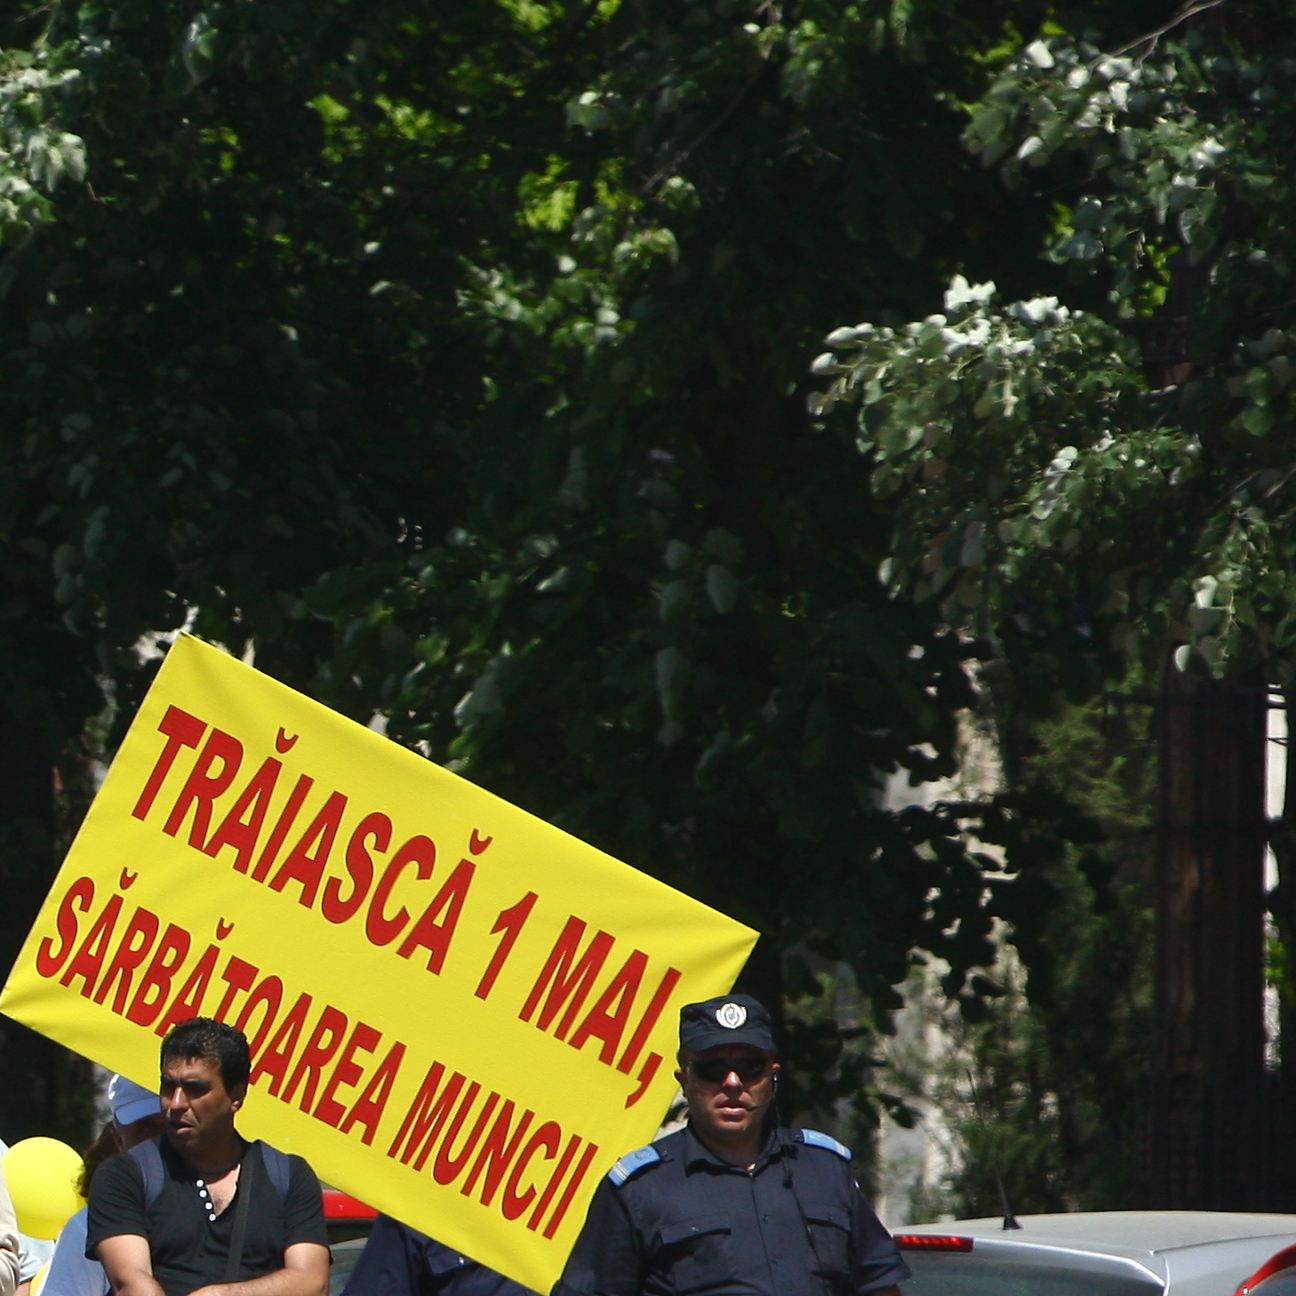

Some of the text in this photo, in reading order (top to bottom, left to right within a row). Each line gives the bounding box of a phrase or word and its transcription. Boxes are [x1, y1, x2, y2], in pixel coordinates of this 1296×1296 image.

[35, 866, 598, 1240] SĂRBĂTOAREA MUNCII
[130, 703, 682, 1109] TRĂIASCĂ 1 MAI,
